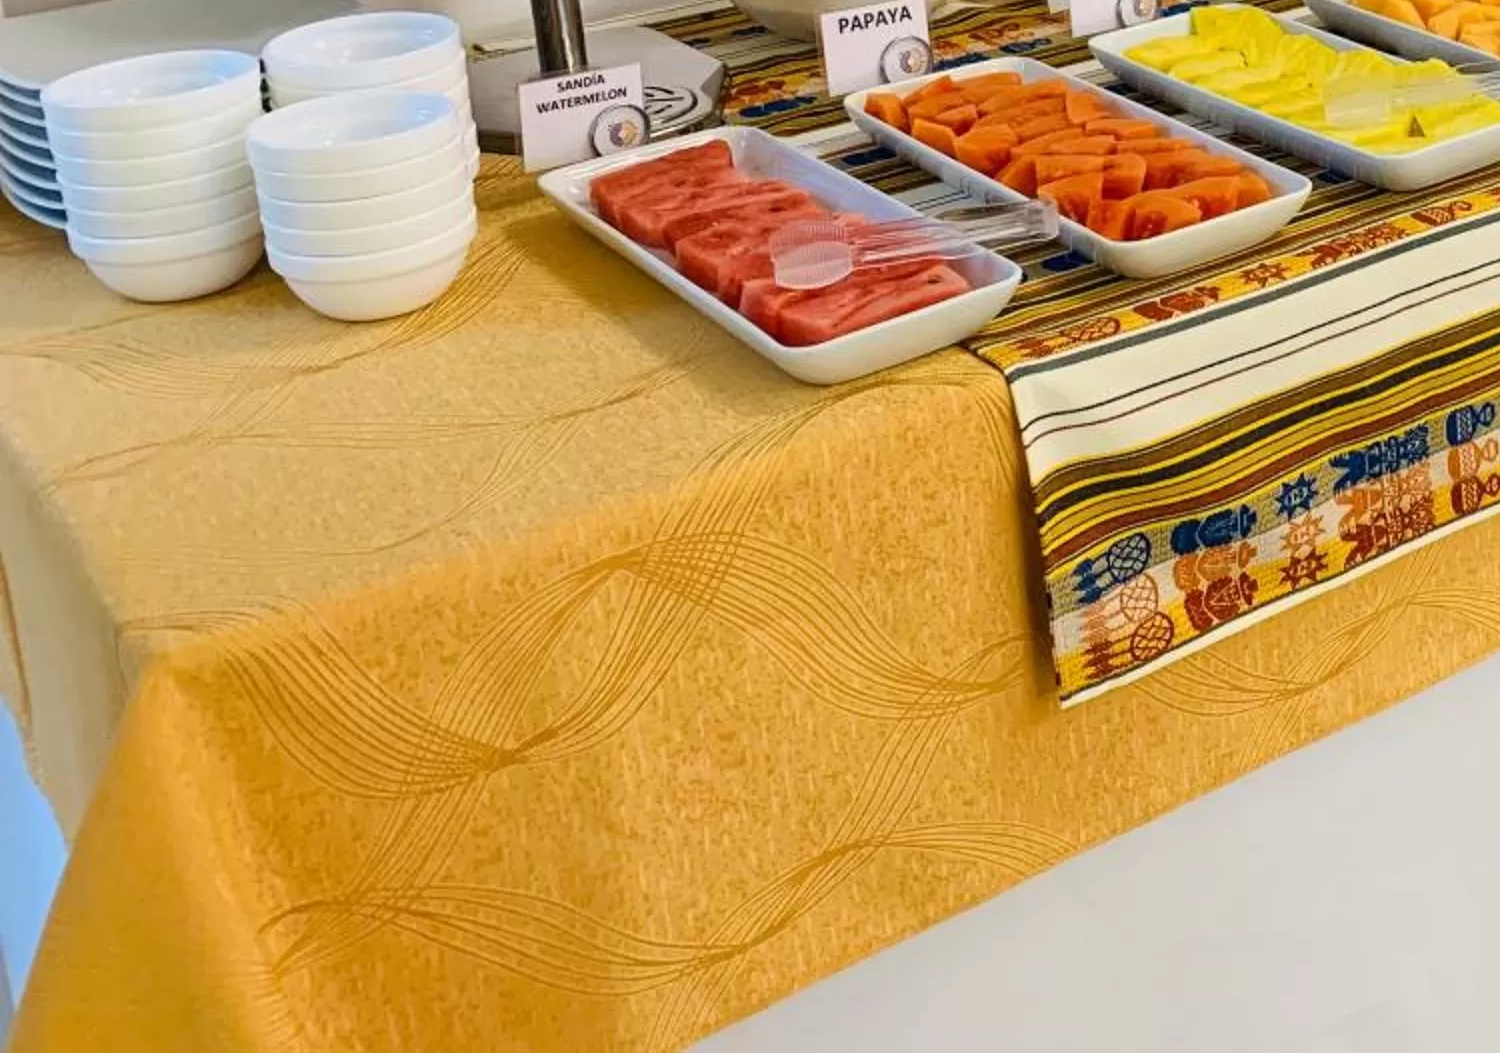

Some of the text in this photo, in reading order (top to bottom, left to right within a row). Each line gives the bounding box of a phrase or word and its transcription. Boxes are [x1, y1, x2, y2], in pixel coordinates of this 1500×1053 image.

[838, 5, 912, 34] PAPAYA
[557, 73, 605, 93] SANDÍA
[536, 87, 627, 115] WATERMELON
